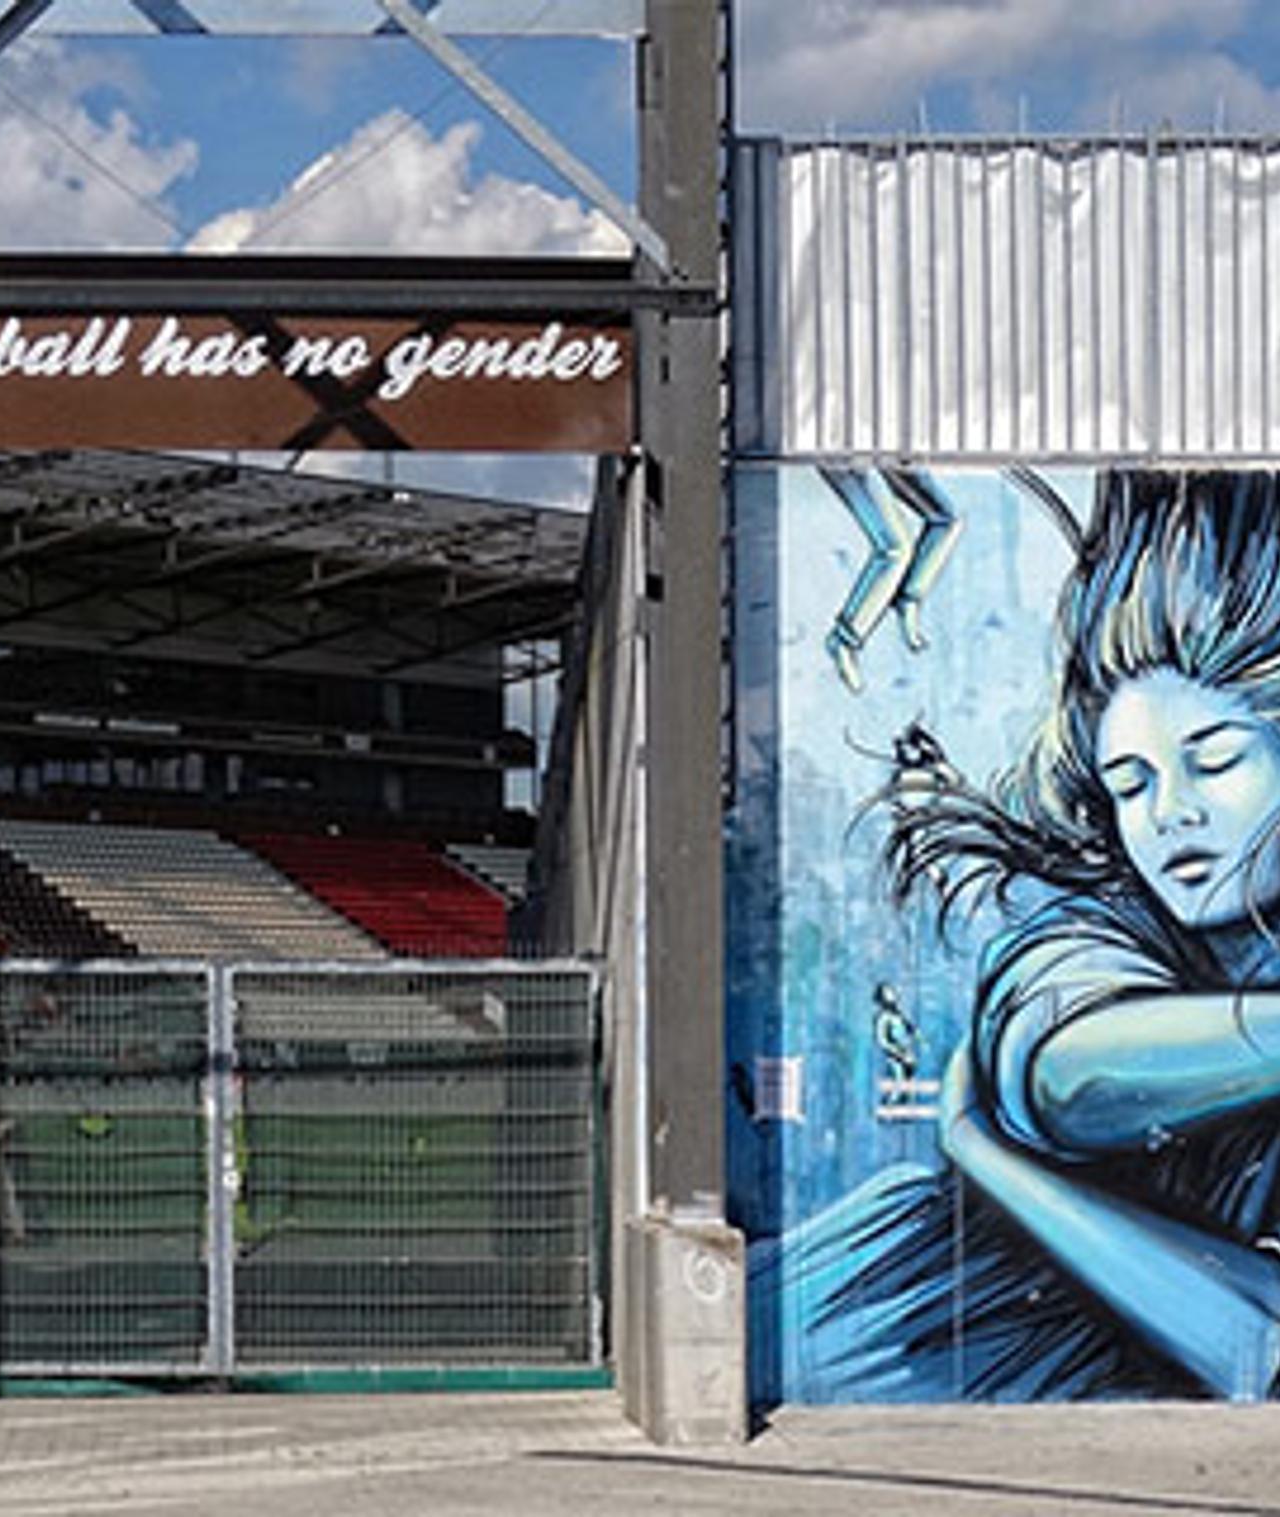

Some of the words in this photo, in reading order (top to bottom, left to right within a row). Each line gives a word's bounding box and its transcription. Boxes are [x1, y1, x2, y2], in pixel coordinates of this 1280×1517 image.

[138, 317, 268, 379] has
[281, 328, 372, 379] no
[379, 322, 622, 399] gender
